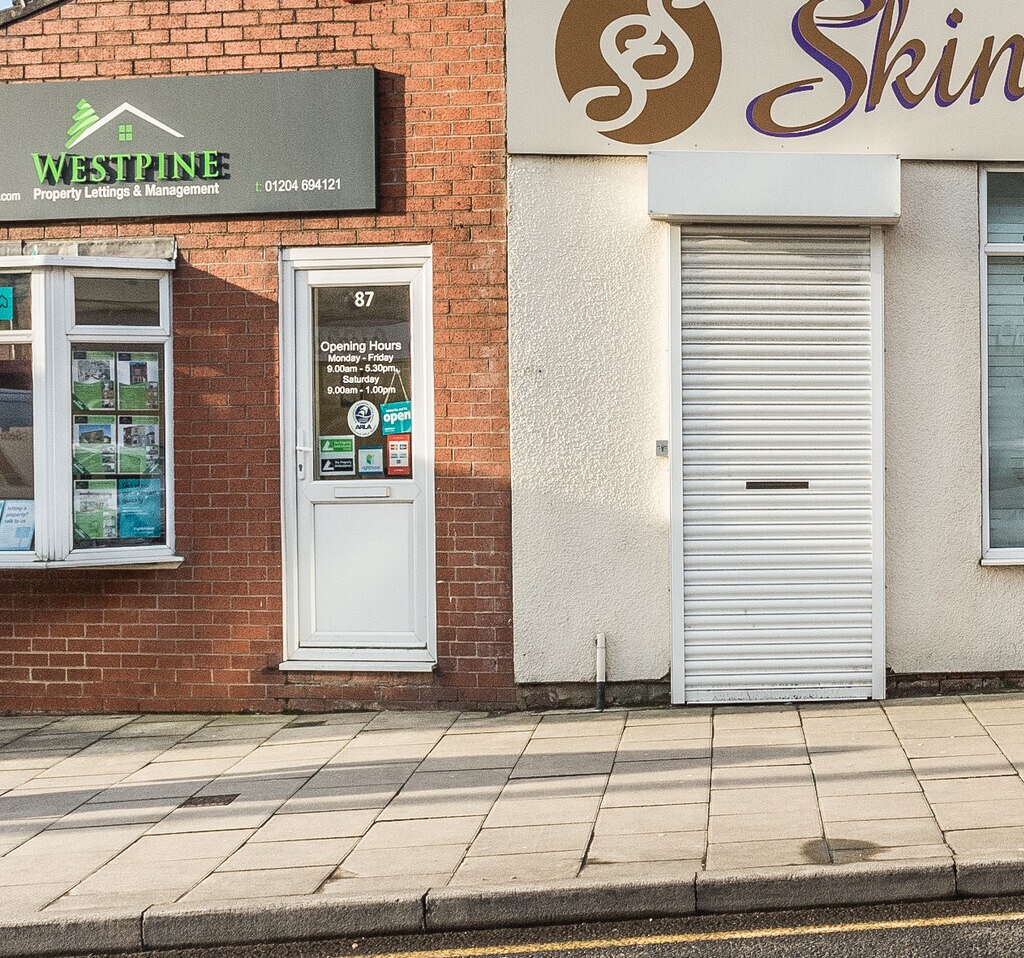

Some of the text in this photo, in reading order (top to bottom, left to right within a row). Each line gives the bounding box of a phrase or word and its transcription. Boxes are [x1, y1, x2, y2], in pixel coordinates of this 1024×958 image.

[31, 150, 220, 184] WESTPINE
[264, 180, 299, 192] 01204
[301, 178, 341, 191] 694121
[33, 182, 220, 202] Property Lettings & Management
[354, 291, 375, 307] 87
[320, 341, 402, 353] Opening Hours
[328, 354, 361, 364] Monday
[367, 354, 394, 363] Friday
[326, 364, 358, 373] 9.00am
[364, 364, 396, 374] 5.30pm
[342, 375, 380, 385] Saturday
[327, 386, 358, 394] 9.00am
[365, 386, 396, 396] 1.00pm
[383, 411, 411, 424] open
